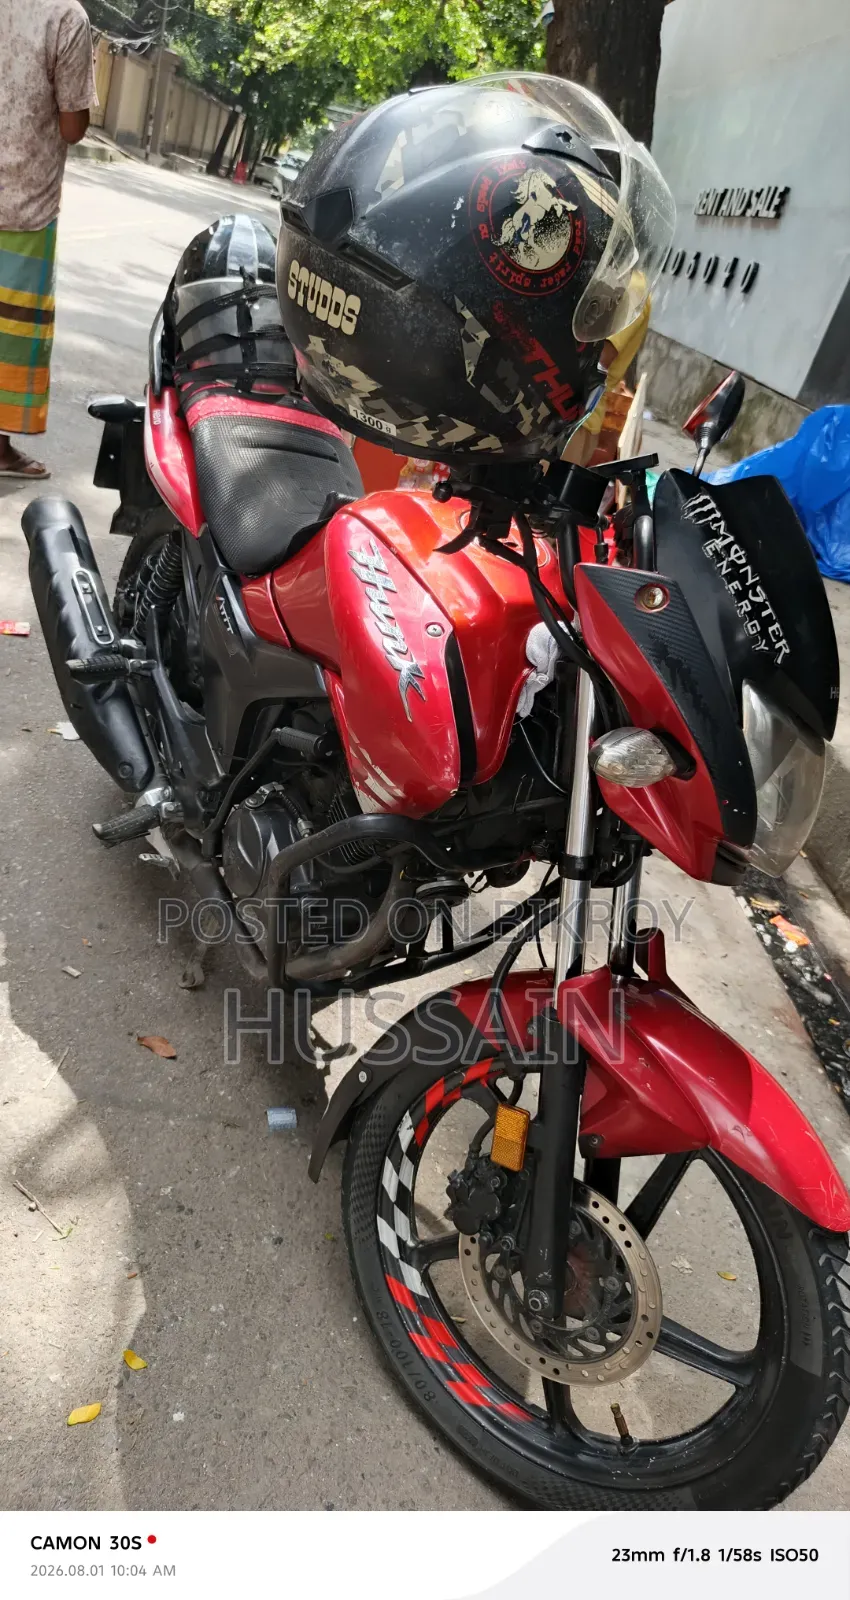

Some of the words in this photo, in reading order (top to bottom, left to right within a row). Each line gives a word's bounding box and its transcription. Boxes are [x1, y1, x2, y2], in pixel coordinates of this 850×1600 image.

[693, 187, 724, 216] RENT
[718, 187, 751, 217] AND
[745, 186, 788, 219] SALE
[287, 259, 361, 336] STUDDS
[488, 251, 532, 288] spirit
[352, 408, 383, 431] 1300
[347, 537, 426, 723] Hunk
[702, 538, 769, 652] ENERGY
[709, 517, 791, 665] MONSTER
[375, 1310, 437, 1402] 80/100-18
